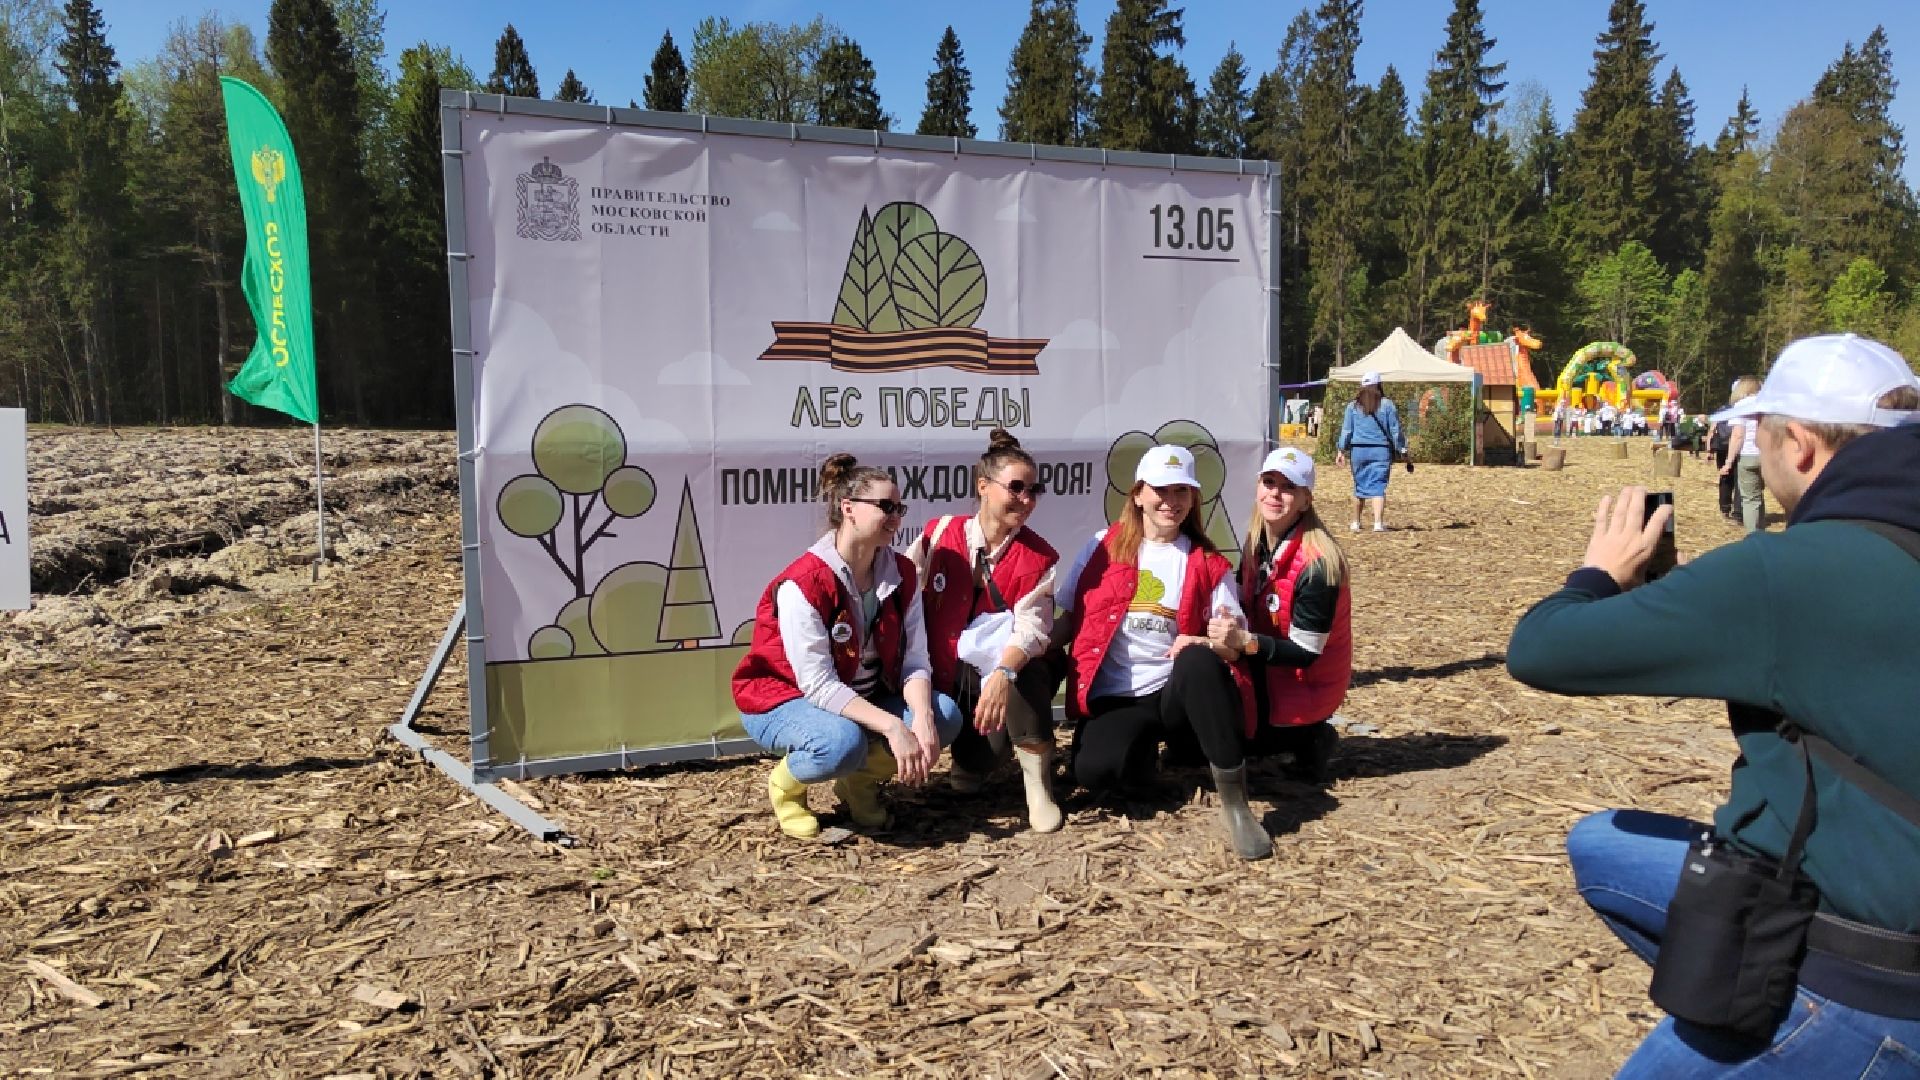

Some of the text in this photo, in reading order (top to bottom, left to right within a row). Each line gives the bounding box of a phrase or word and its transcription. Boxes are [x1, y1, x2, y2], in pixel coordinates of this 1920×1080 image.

[591, 187, 730, 207] ПРАВИТЕЛЬСТВО
[591, 204, 706, 222] МОСКОВСКОЙ
[591, 222, 670, 237] ОБЛАСТИ
[1149, 204, 1234, 252] 13.05
[265, 221, 290, 367] ОСЛЕСХОЗ
[790, 385, 1031, 431] ЛЕС ПОБЕДЫ
[721, 467, 829, 505] ПОМНИ
[1039, 461, 1093, 496] РОЯ!
